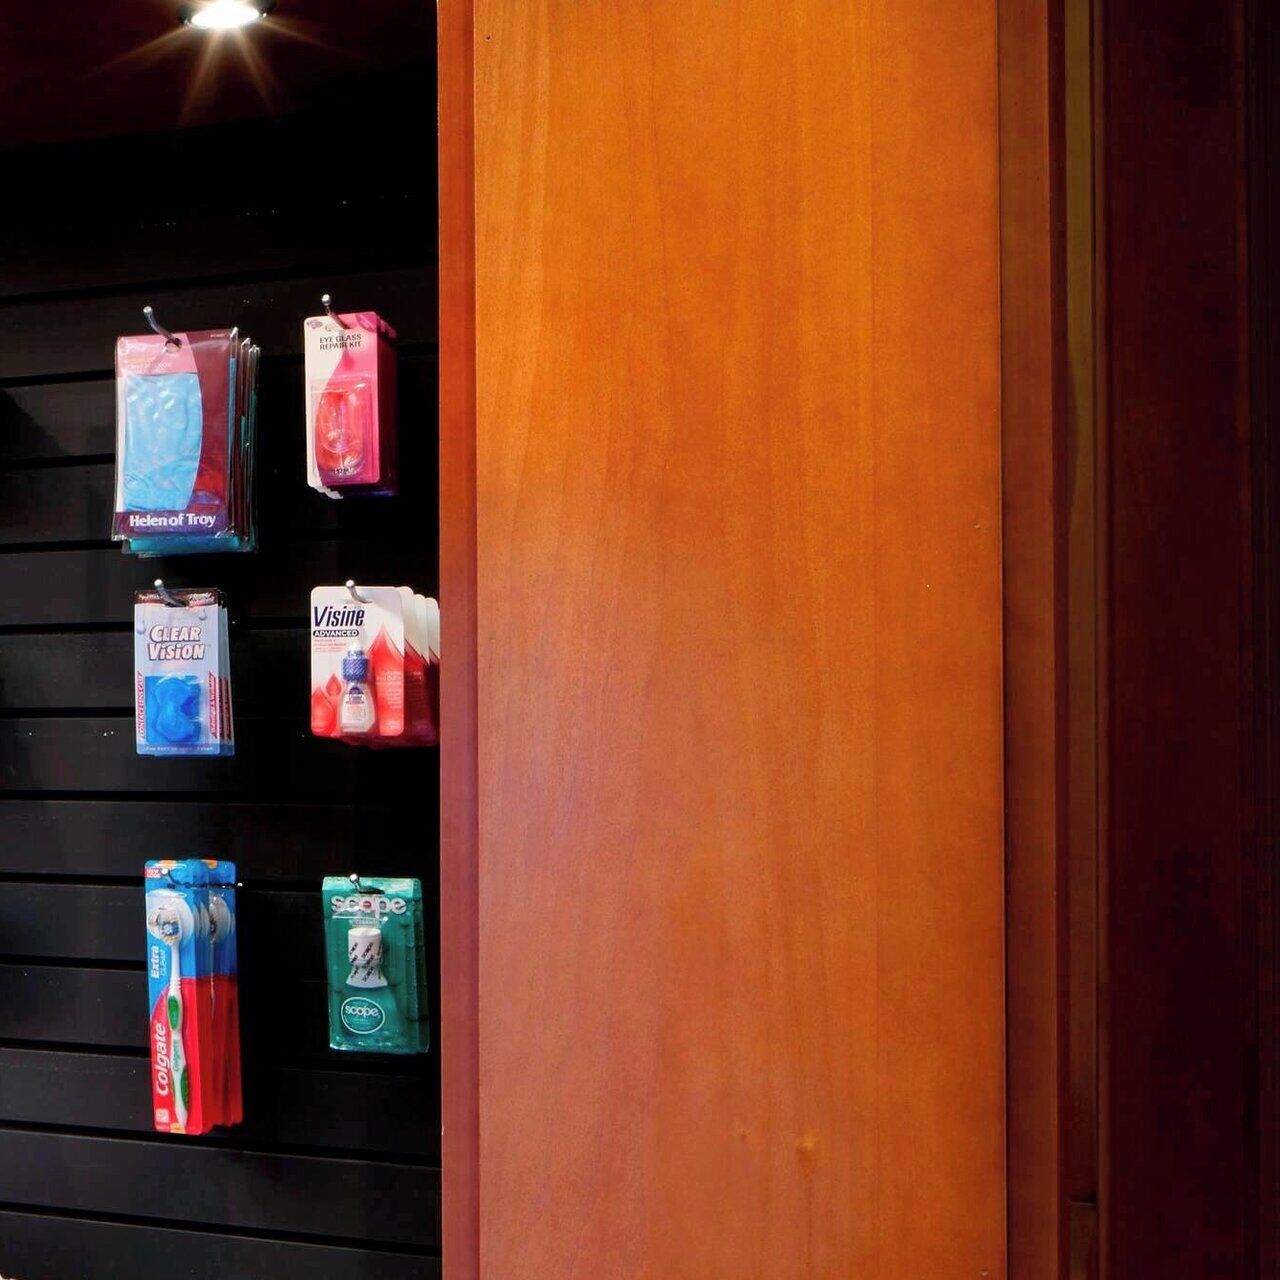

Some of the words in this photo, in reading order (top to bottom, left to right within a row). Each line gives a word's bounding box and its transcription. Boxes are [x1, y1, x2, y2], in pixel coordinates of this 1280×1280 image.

[320, 342, 348, 350] REPAIR
[336, 334, 362, 342] GLASS
[129, 514, 168, 527] Helen
[168, 513, 185, 526] of
[186, 513, 217, 528] Troy
[313, 605, 365, 628] Visine
[149, 624, 202, 643] CLEAR
[331, 896, 407, 918] scope
[151, 945, 160, 979] Extra
[345, 1004, 380, 1018] scope
[156, 1022, 173, 1096] Colgate
